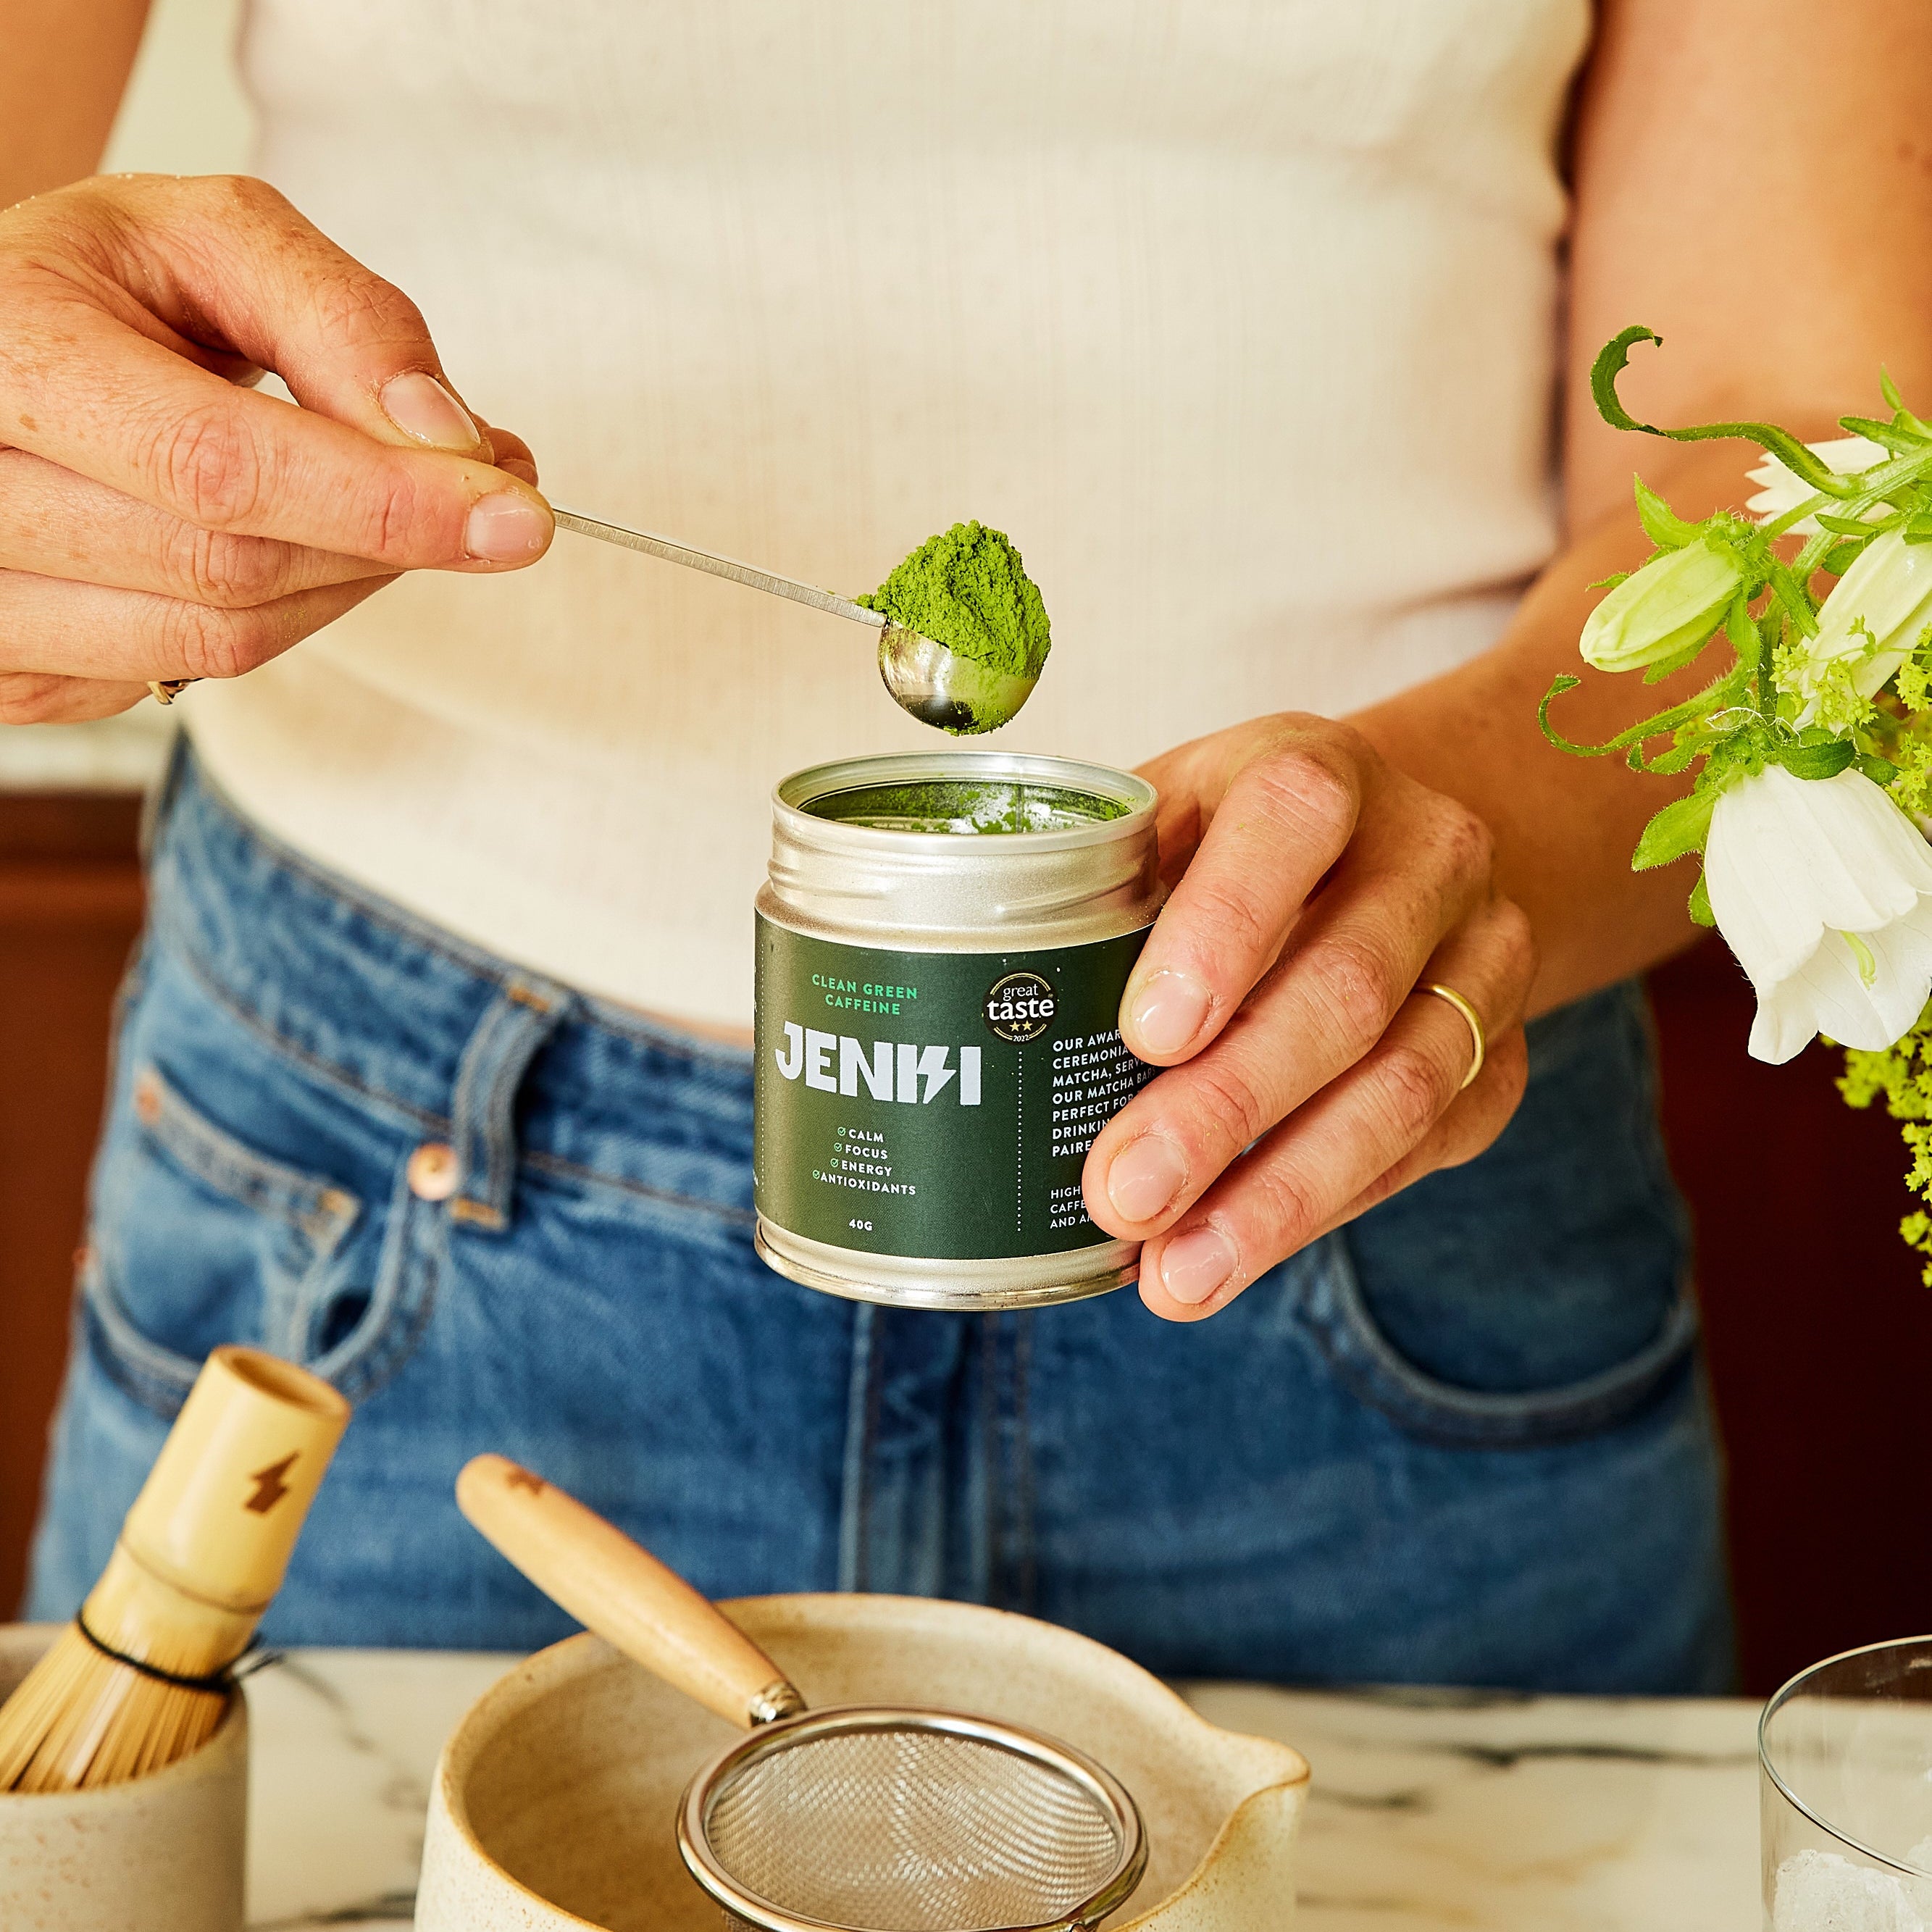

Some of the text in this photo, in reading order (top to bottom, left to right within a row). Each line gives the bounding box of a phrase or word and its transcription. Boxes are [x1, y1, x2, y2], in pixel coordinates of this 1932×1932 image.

[812, 974, 917, 999] CLEAN GREEN
[1003, 983, 1039, 1001] great
[825, 994, 900, 1015] CAFFEINE
[987, 998, 1054, 1021] taste
[1053, 1037, 1084, 1053] OUR
[775, 1020, 981, 1105] JENKI
[1053, 1067, 1112, 1087] MATCHA,
[1053, 1090, 1083, 1105] OUR
[1087, 1076, 1134, 1099] MATCHA
[1053, 1100, 1110, 1122] PERFECT
[848, 1129, 884, 1143] CALM
[845, 1144, 888, 1160] FOCUS
[1053, 1138, 1096, 1157] PAIRE
[841, 1160, 892, 1176] ENERGY
[820, 1171, 916, 1195] ANTIOXIDANTS
[1050, 1185, 1081, 1200] HIGH
[848, 1218, 873, 1231] 40G
[1050, 1216, 1076, 1229] AND
